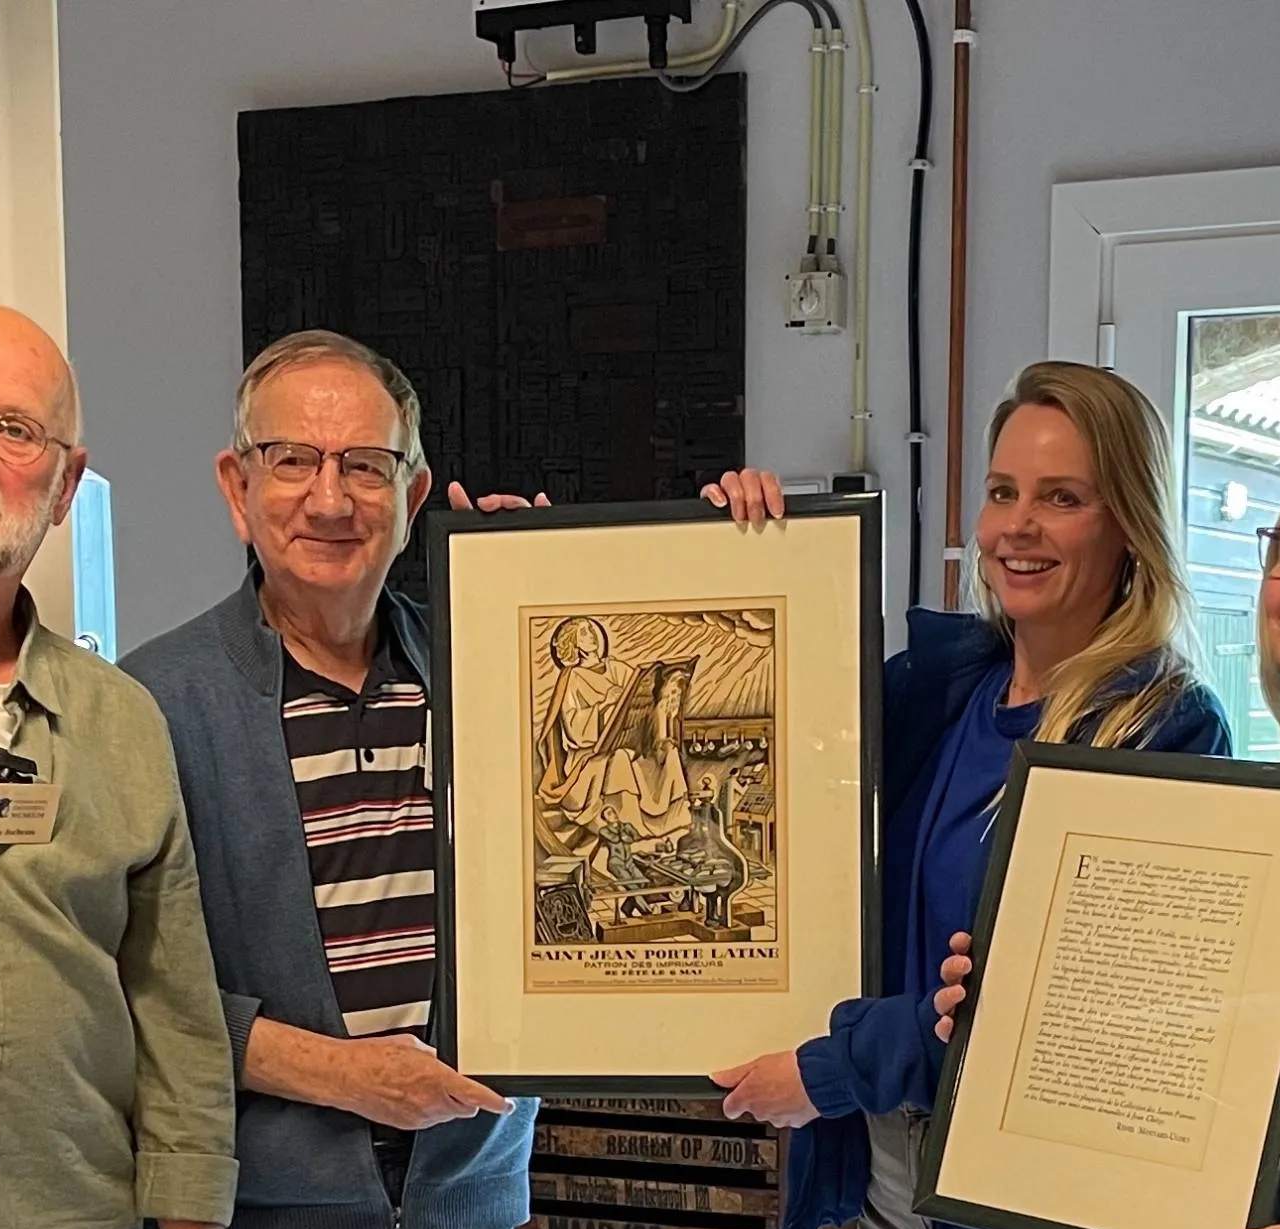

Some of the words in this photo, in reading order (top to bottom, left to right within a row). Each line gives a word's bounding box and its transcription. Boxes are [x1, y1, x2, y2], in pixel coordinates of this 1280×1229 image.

[531, 950, 586, 961] SAINT
[590, 949, 636, 960] JEAN
[645, 948, 703, 960] PORTE
[711, 948, 780, 959] LATINE
[584, 961, 628, 969] PATRON
[656, 960, 724, 968] IMPRIMEURS
[681, 1137, 703, 1161] OP
